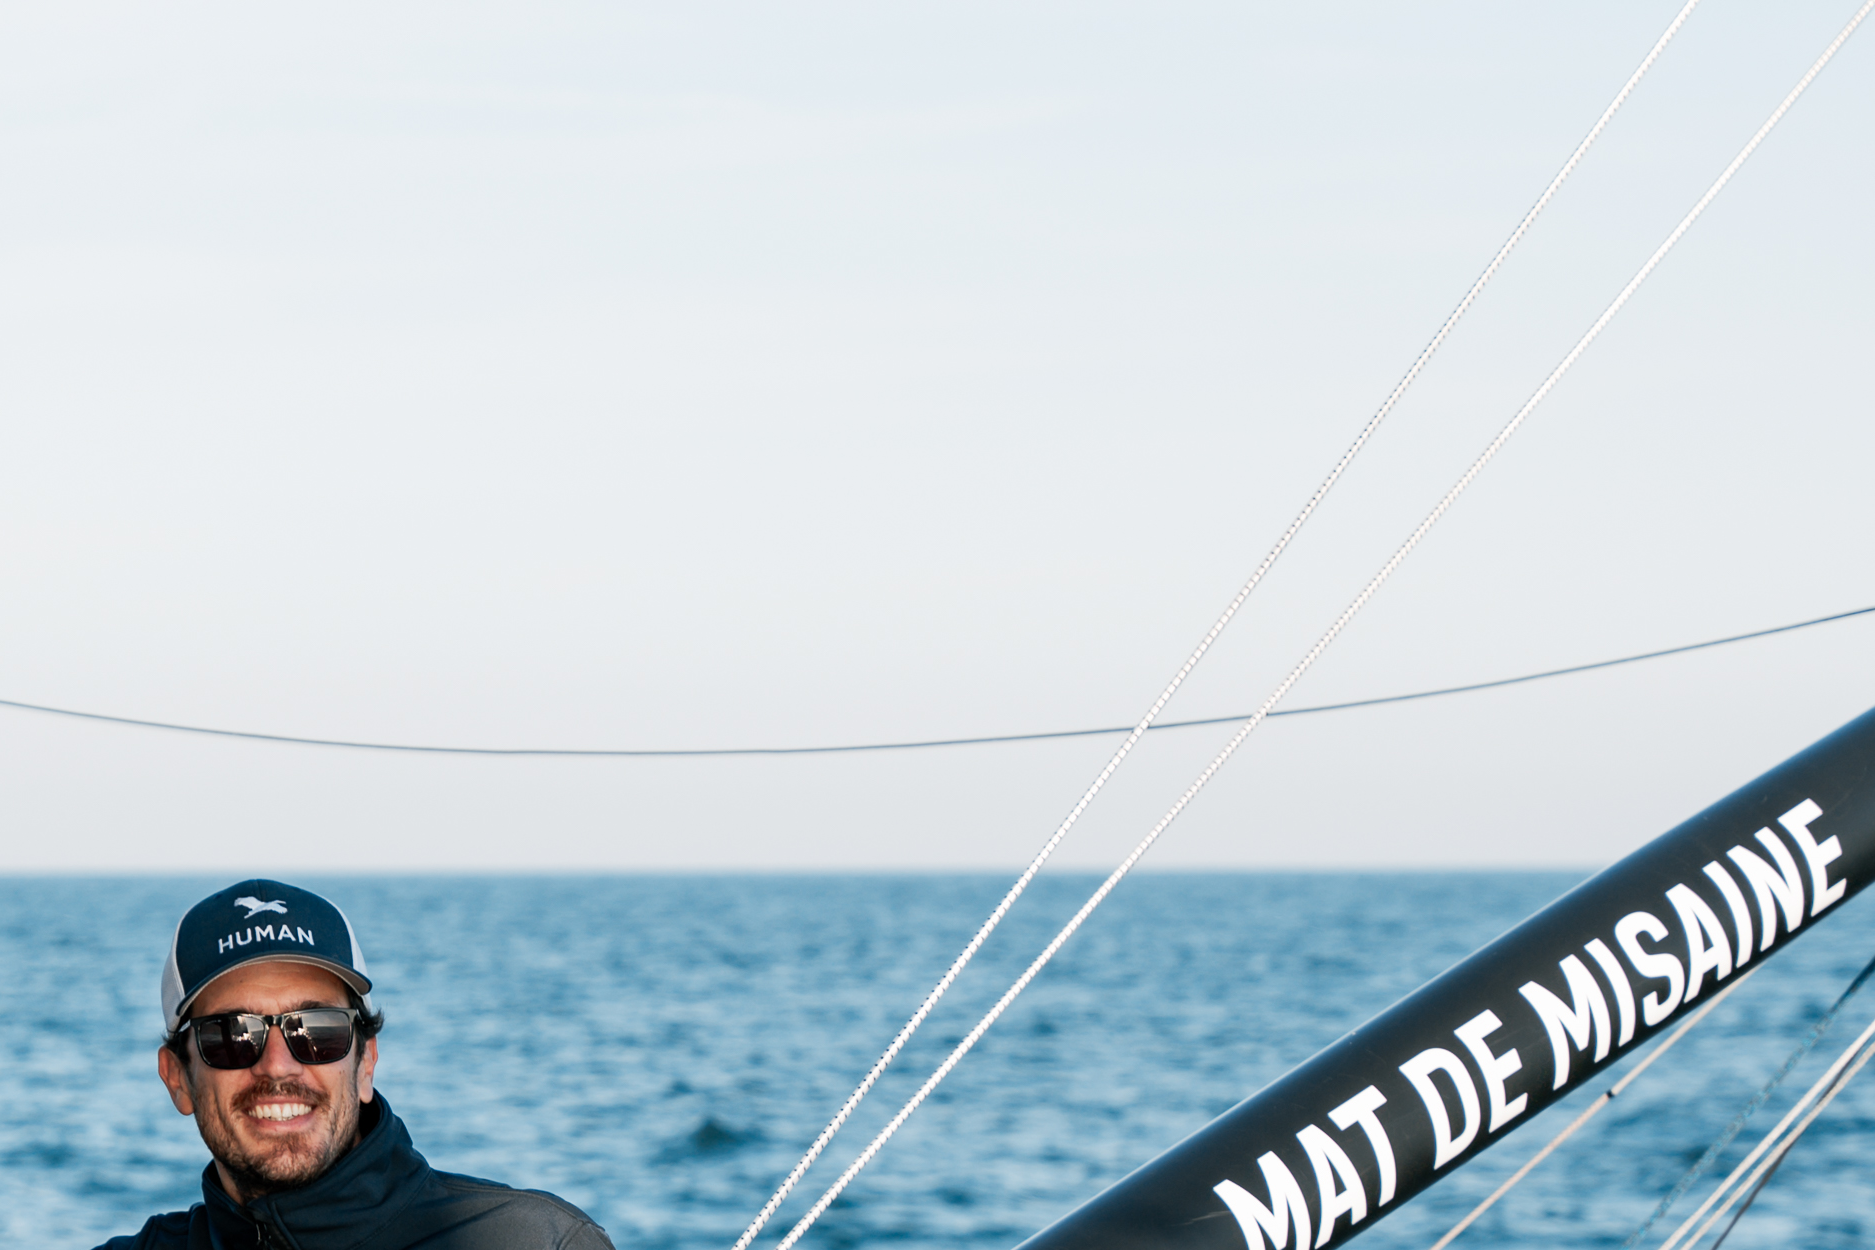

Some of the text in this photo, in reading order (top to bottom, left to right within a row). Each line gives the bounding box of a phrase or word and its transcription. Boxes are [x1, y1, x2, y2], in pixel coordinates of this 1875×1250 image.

[218, 924, 315, 954] HUMAN
[1399, 1009, 1528, 1171] DE
[1518, 797, 1847, 1091] MISAINE
